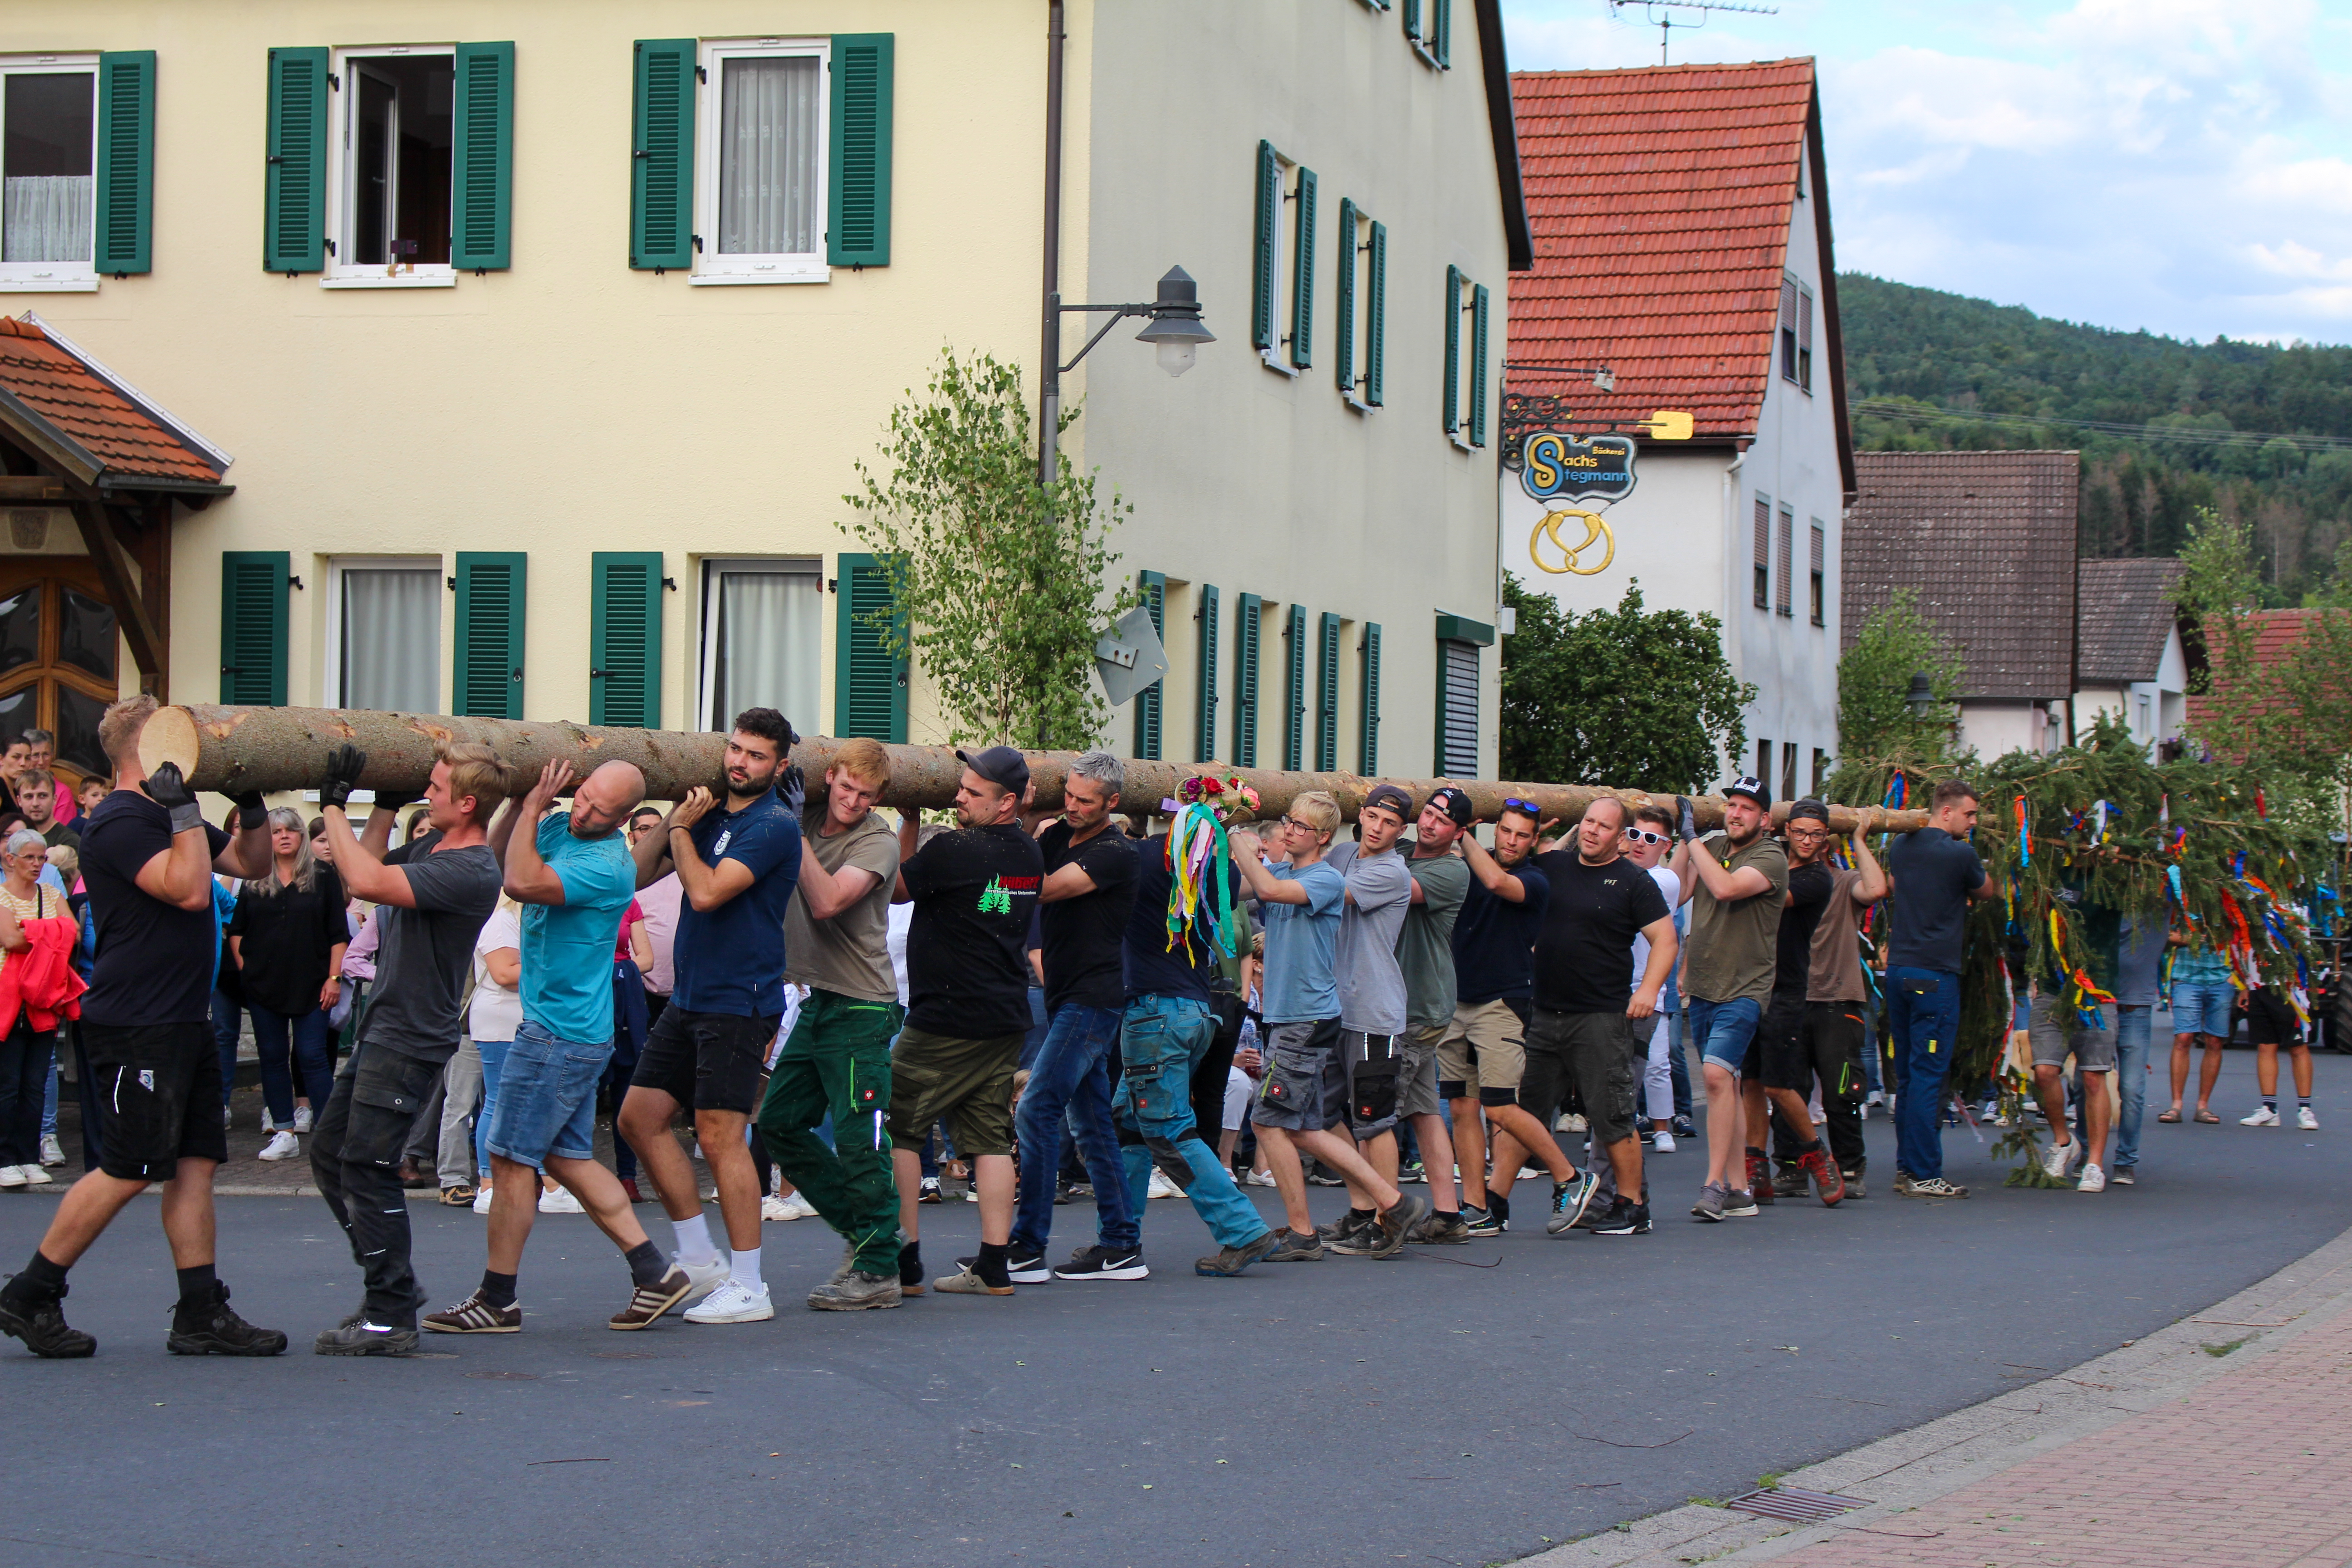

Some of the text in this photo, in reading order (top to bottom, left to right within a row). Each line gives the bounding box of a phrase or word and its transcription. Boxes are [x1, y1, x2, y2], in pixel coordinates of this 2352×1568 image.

[1529, 435, 1598, 487] Sachs
[1592, 445, 1626, 456] Bäckerei
[1528, 442, 1629, 495] Stegmann
[999, 876, 1040, 888] Hilbert
